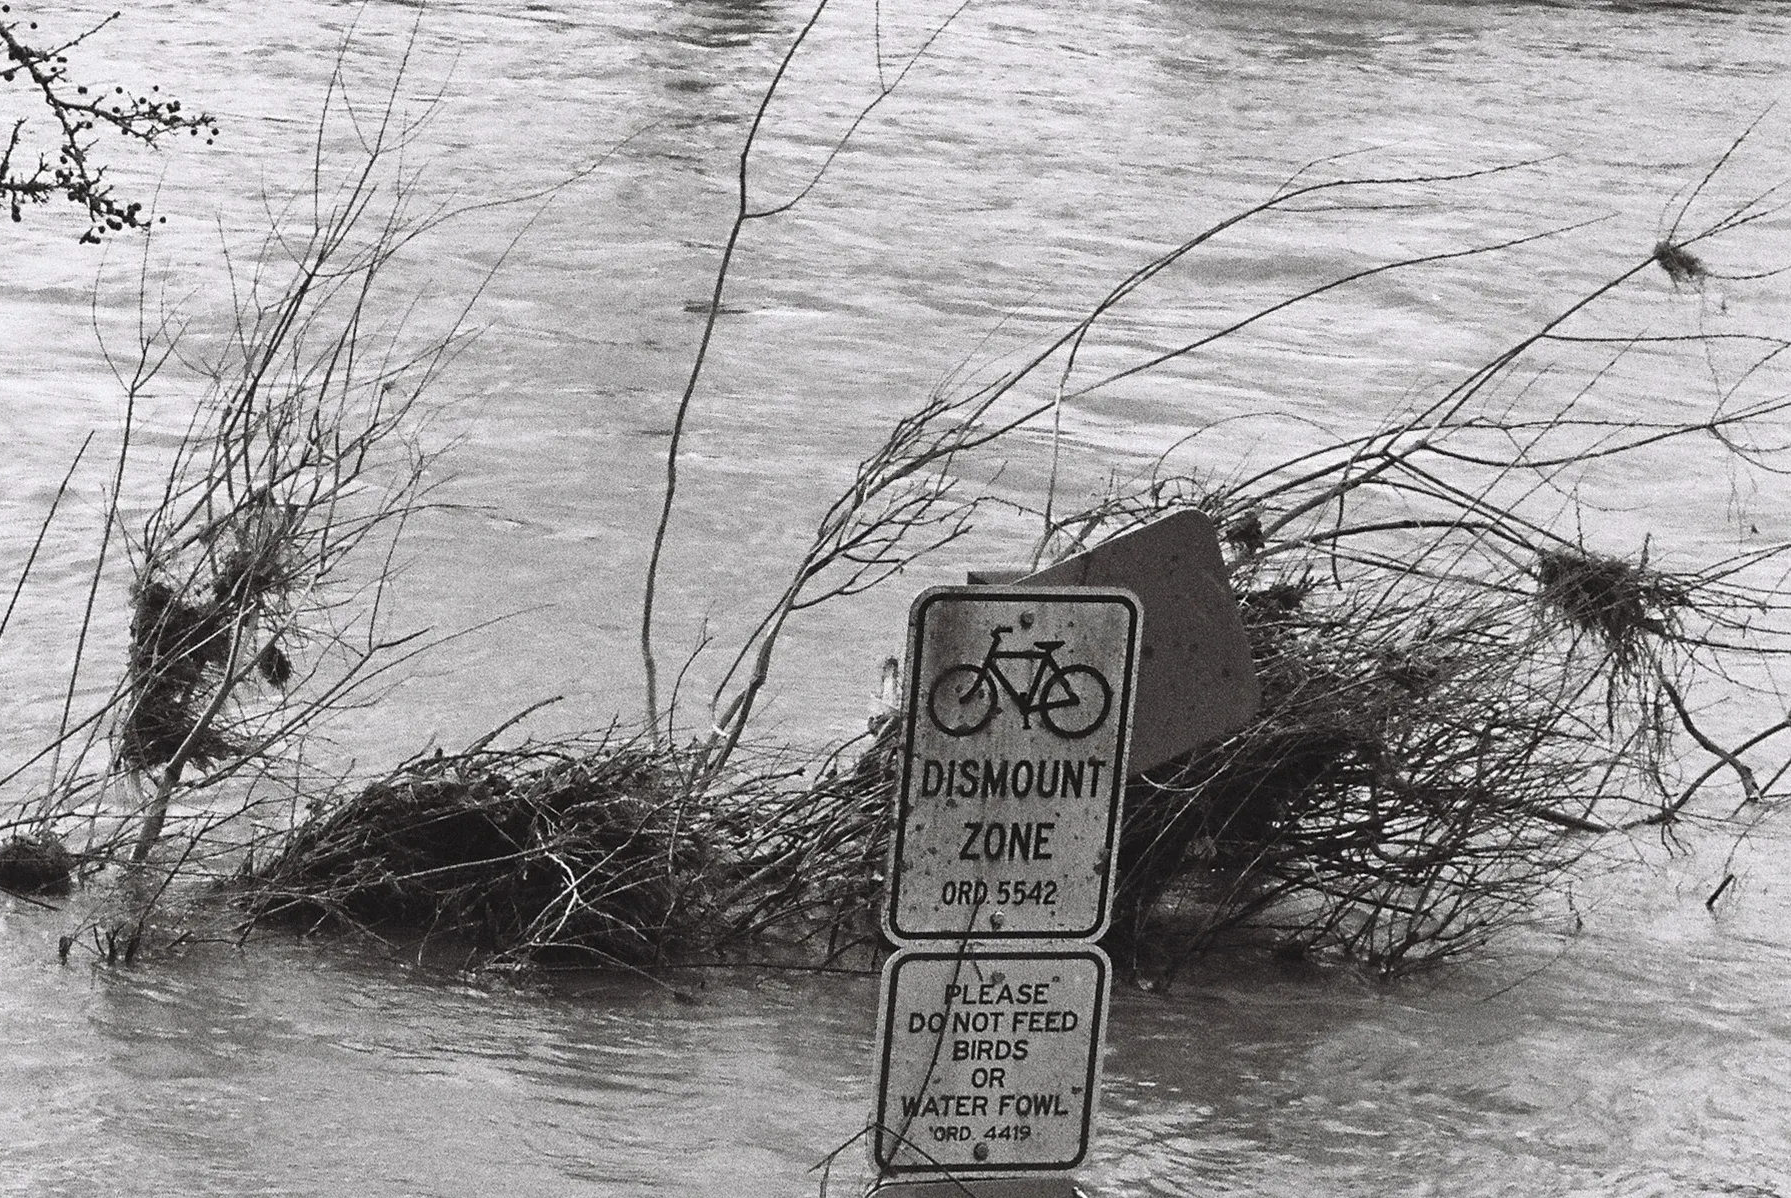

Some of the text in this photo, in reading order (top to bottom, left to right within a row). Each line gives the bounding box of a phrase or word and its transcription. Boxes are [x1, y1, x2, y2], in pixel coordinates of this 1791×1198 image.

[921, 758, 1106, 798] DISMOUNT
[959, 821, 1056, 861] ZONE
[996, 880, 1058, 906] 5542
[943, 983, 1050, 1005] PLEASE
[908, 1009, 1079, 1034] DO NOT FEED
[951, 1039, 1029, 1061] BIRDS
[971, 1067, 1005, 1088] OR
[901, 1094, 1069, 1118] WATER FOWL
[983, 1125, 1032, 1142] 4419
